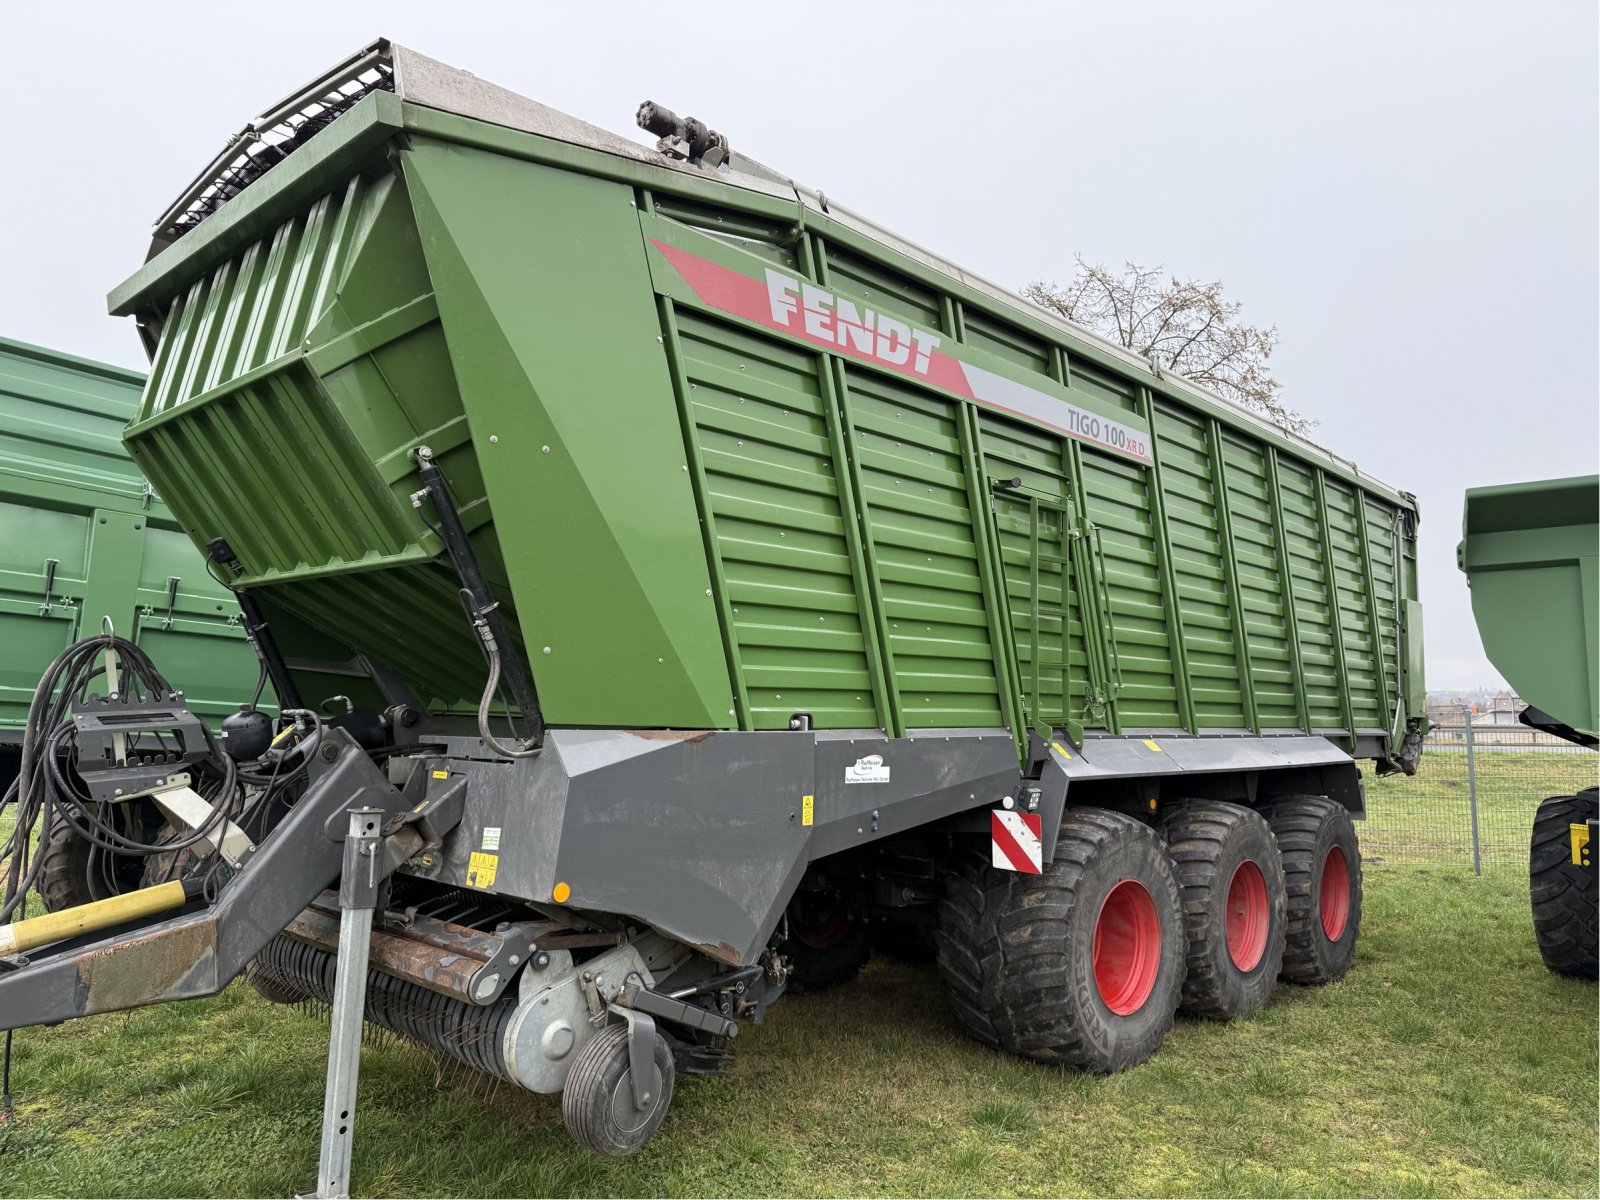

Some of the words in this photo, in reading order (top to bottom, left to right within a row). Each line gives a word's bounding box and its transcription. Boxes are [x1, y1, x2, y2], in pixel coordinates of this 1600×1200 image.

[765, 267, 941, 375] FENDT
[1068, 408, 1100, 439] TIGO
[1104, 423, 1125, 448] 100
[1126, 437, 1137, 453] XR
[1138, 443, 1145, 456] D
